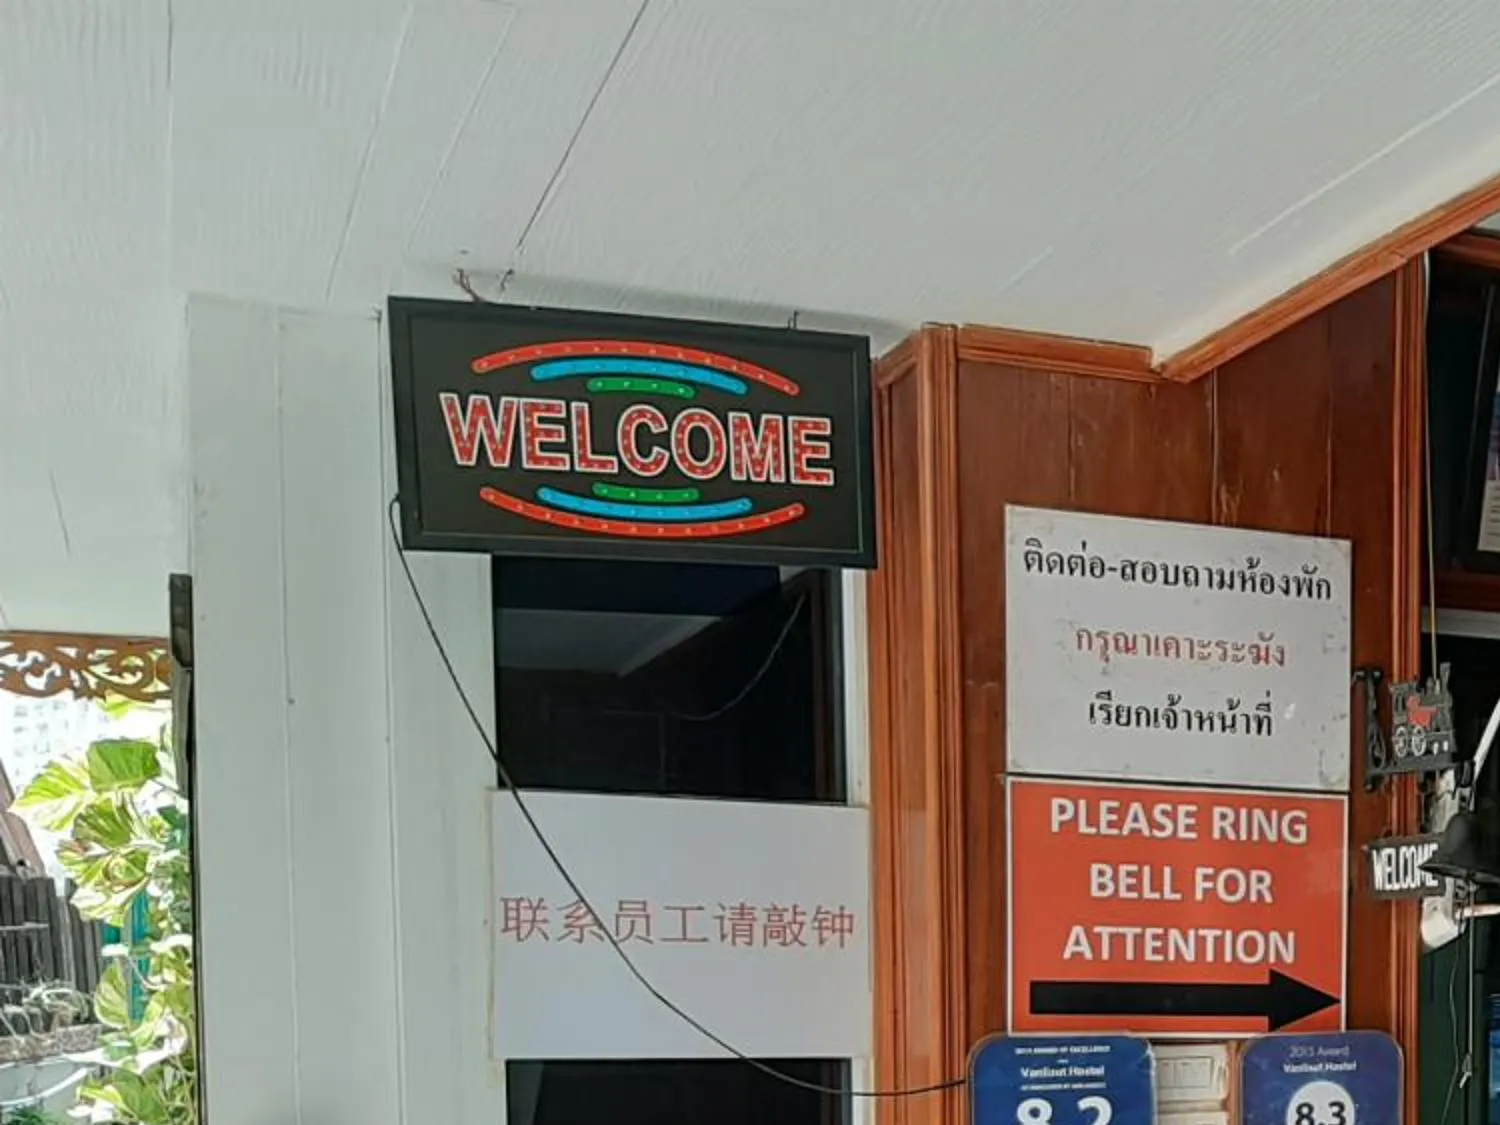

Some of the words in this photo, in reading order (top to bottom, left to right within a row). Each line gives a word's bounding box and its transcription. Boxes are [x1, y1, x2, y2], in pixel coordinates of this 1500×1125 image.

[439, 392, 834, 486] WELCOME
[1023, 537, 1332, 601] ติดต่อ-สอบถามห้องพัก
[1075, 628, 1286, 667] กรุณาเคาะระฆัง
[1088, 689, 1272, 737] เรียกเจ้าหน้าที่
[1050, 797, 1198, 840] PLEASE
[1212, 806, 1309, 844] RING
[1089, 863, 1182, 901] BELL
[1194, 867, 1273, 904] FOR
[499, 896, 855, 949] 联系员工请敲钟
[1062, 925, 1296, 965] ATTENTION
